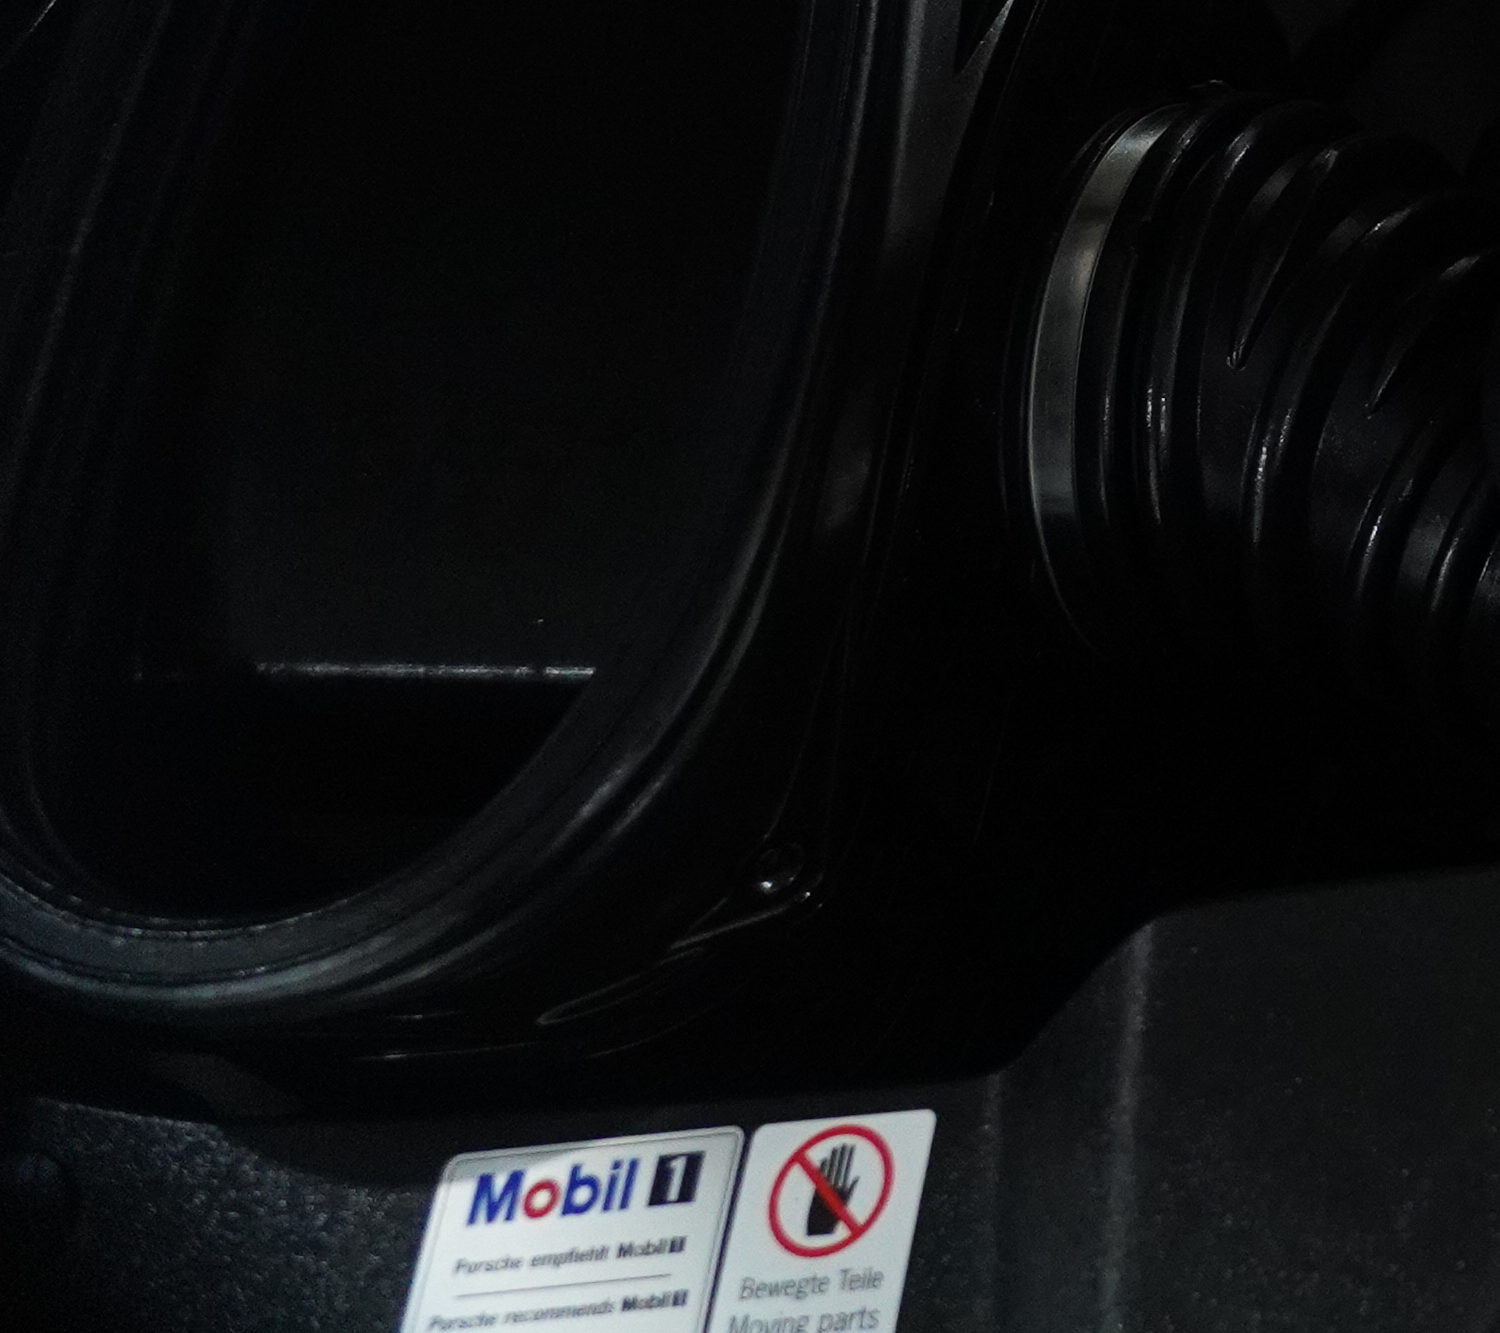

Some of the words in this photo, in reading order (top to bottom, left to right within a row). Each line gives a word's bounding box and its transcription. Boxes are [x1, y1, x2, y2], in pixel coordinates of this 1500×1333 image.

[466, 1158, 640, 1227] Mobil
[739, 1272, 831, 1301] Bewegte
[839, 1267, 886, 1292] Teile
[728, 1311, 810, 1333] Moving
[818, 1306, 882, 1333] parts
